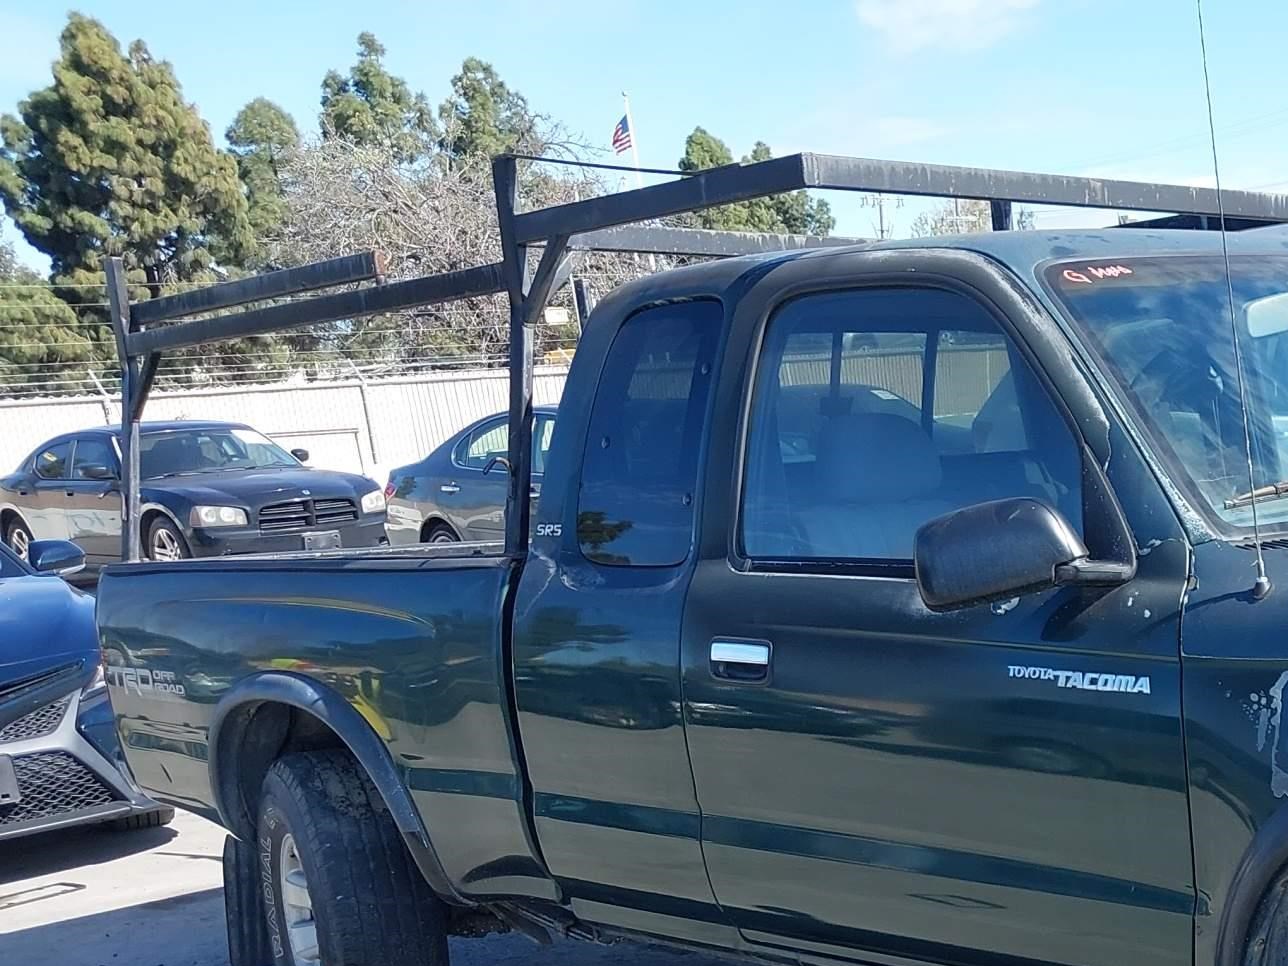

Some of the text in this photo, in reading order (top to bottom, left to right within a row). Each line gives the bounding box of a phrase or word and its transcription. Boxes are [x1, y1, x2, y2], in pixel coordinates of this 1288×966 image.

[105, 665, 153, 696] TRD
[152, 670, 176, 681] OFF
[154, 682, 185, 697] ROAD
[1007, 665, 1151, 694] TOYOTA TACOMA
[260, 836, 284, 959] RADIAL
